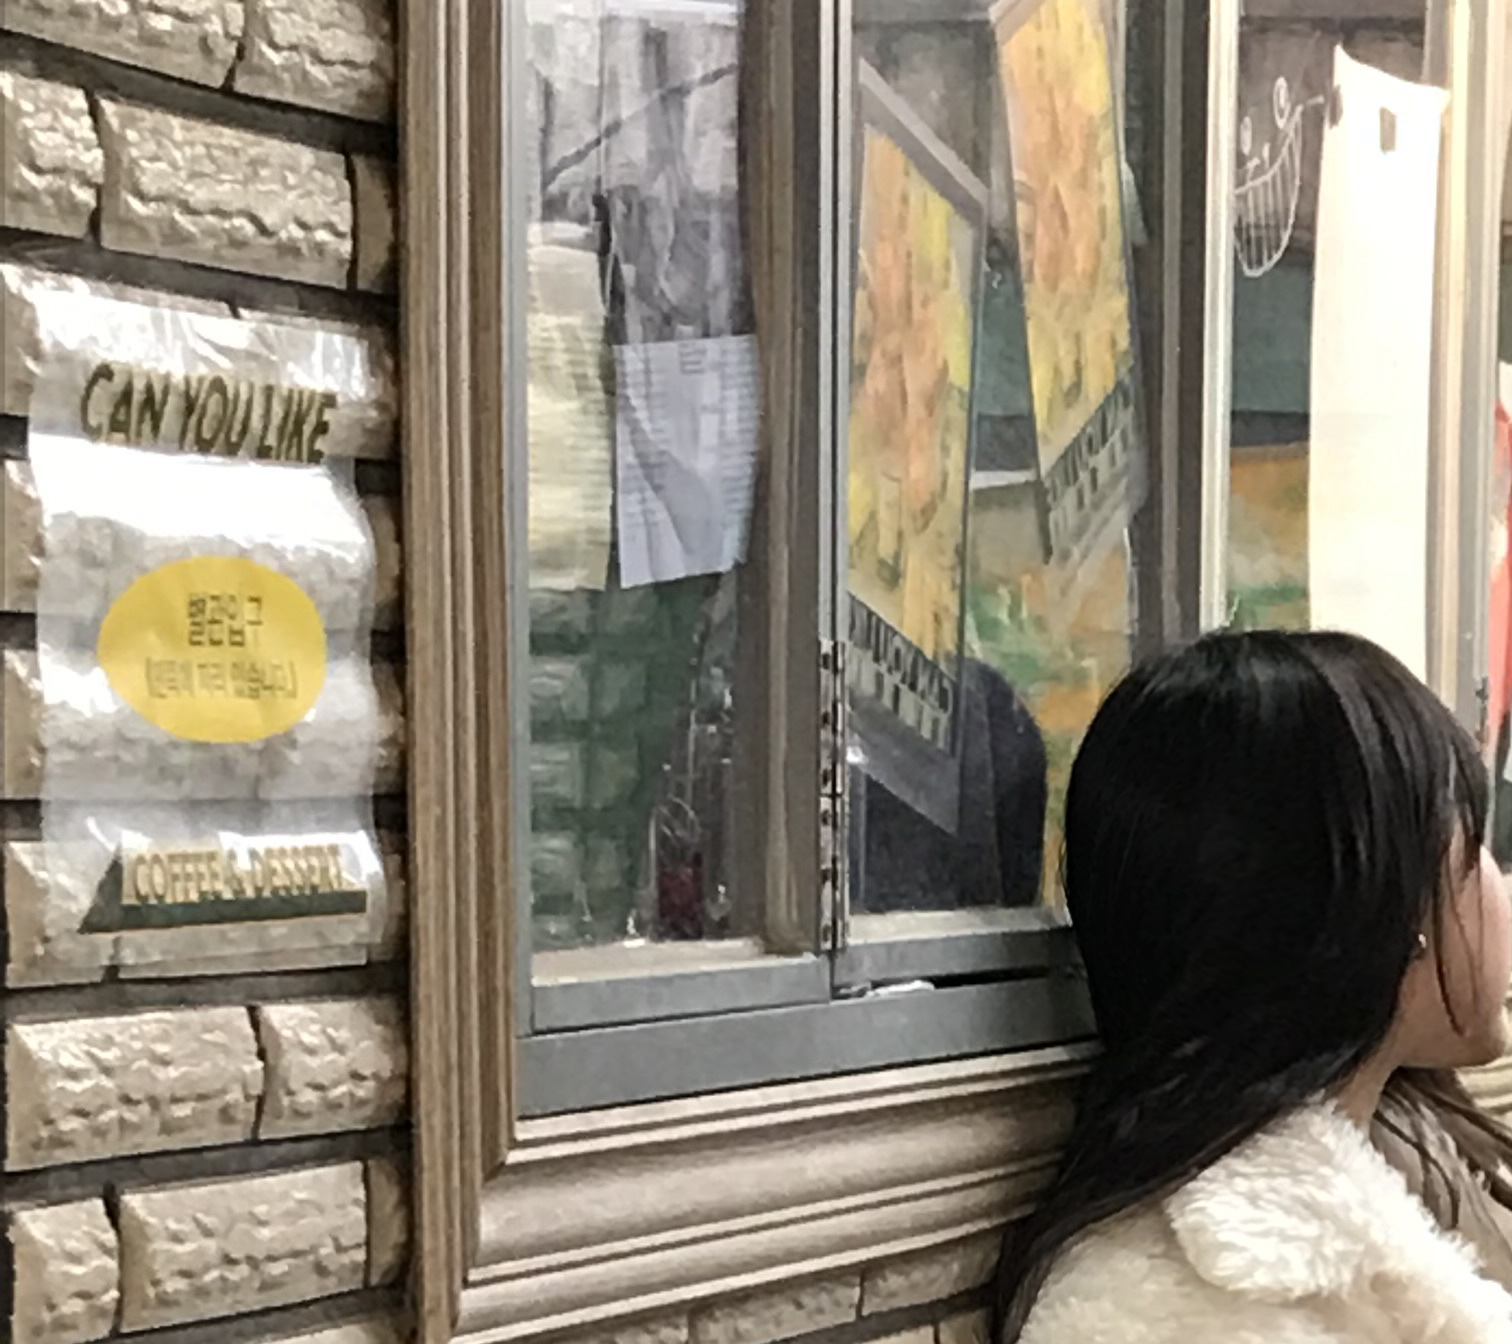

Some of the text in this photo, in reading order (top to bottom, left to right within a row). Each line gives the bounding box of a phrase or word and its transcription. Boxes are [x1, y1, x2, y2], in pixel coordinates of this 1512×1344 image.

[81, 363, 338, 464] CAN YOU LIKE
[133, 851, 222, 904] COFFEE
